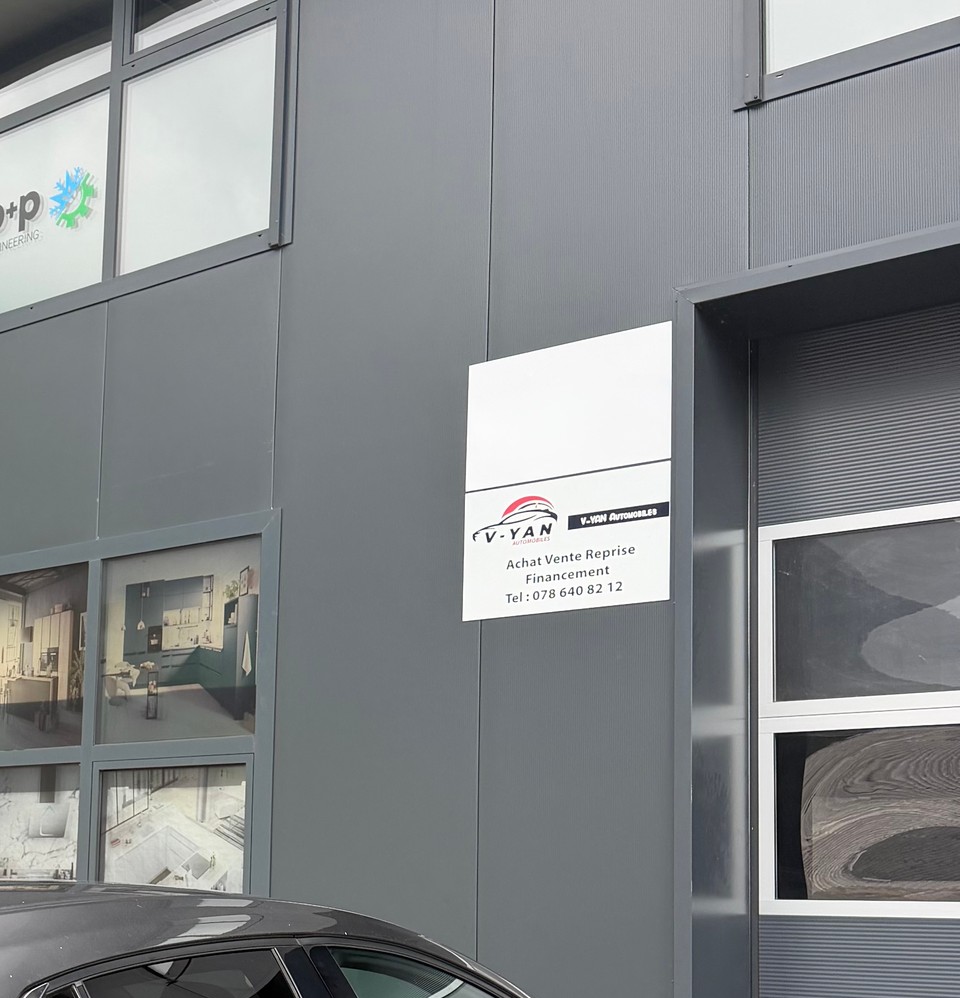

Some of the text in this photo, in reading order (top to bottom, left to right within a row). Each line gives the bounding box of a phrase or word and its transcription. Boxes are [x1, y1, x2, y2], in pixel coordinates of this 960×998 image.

[580, 513, 607, 526] V-YAN
[485, 523, 553, 543] V-YAN
[512, 535, 551, 546] AUTOMOBILES
[506, 544, 636, 570] Achat Vente Reprise
[525, 565, 610, 585] Financement
[532, 588, 556, 601] 078
[559, 585, 584, 597] 640
[587, 583, 603, 594] 82
[607, 581, 623, 593] 12
